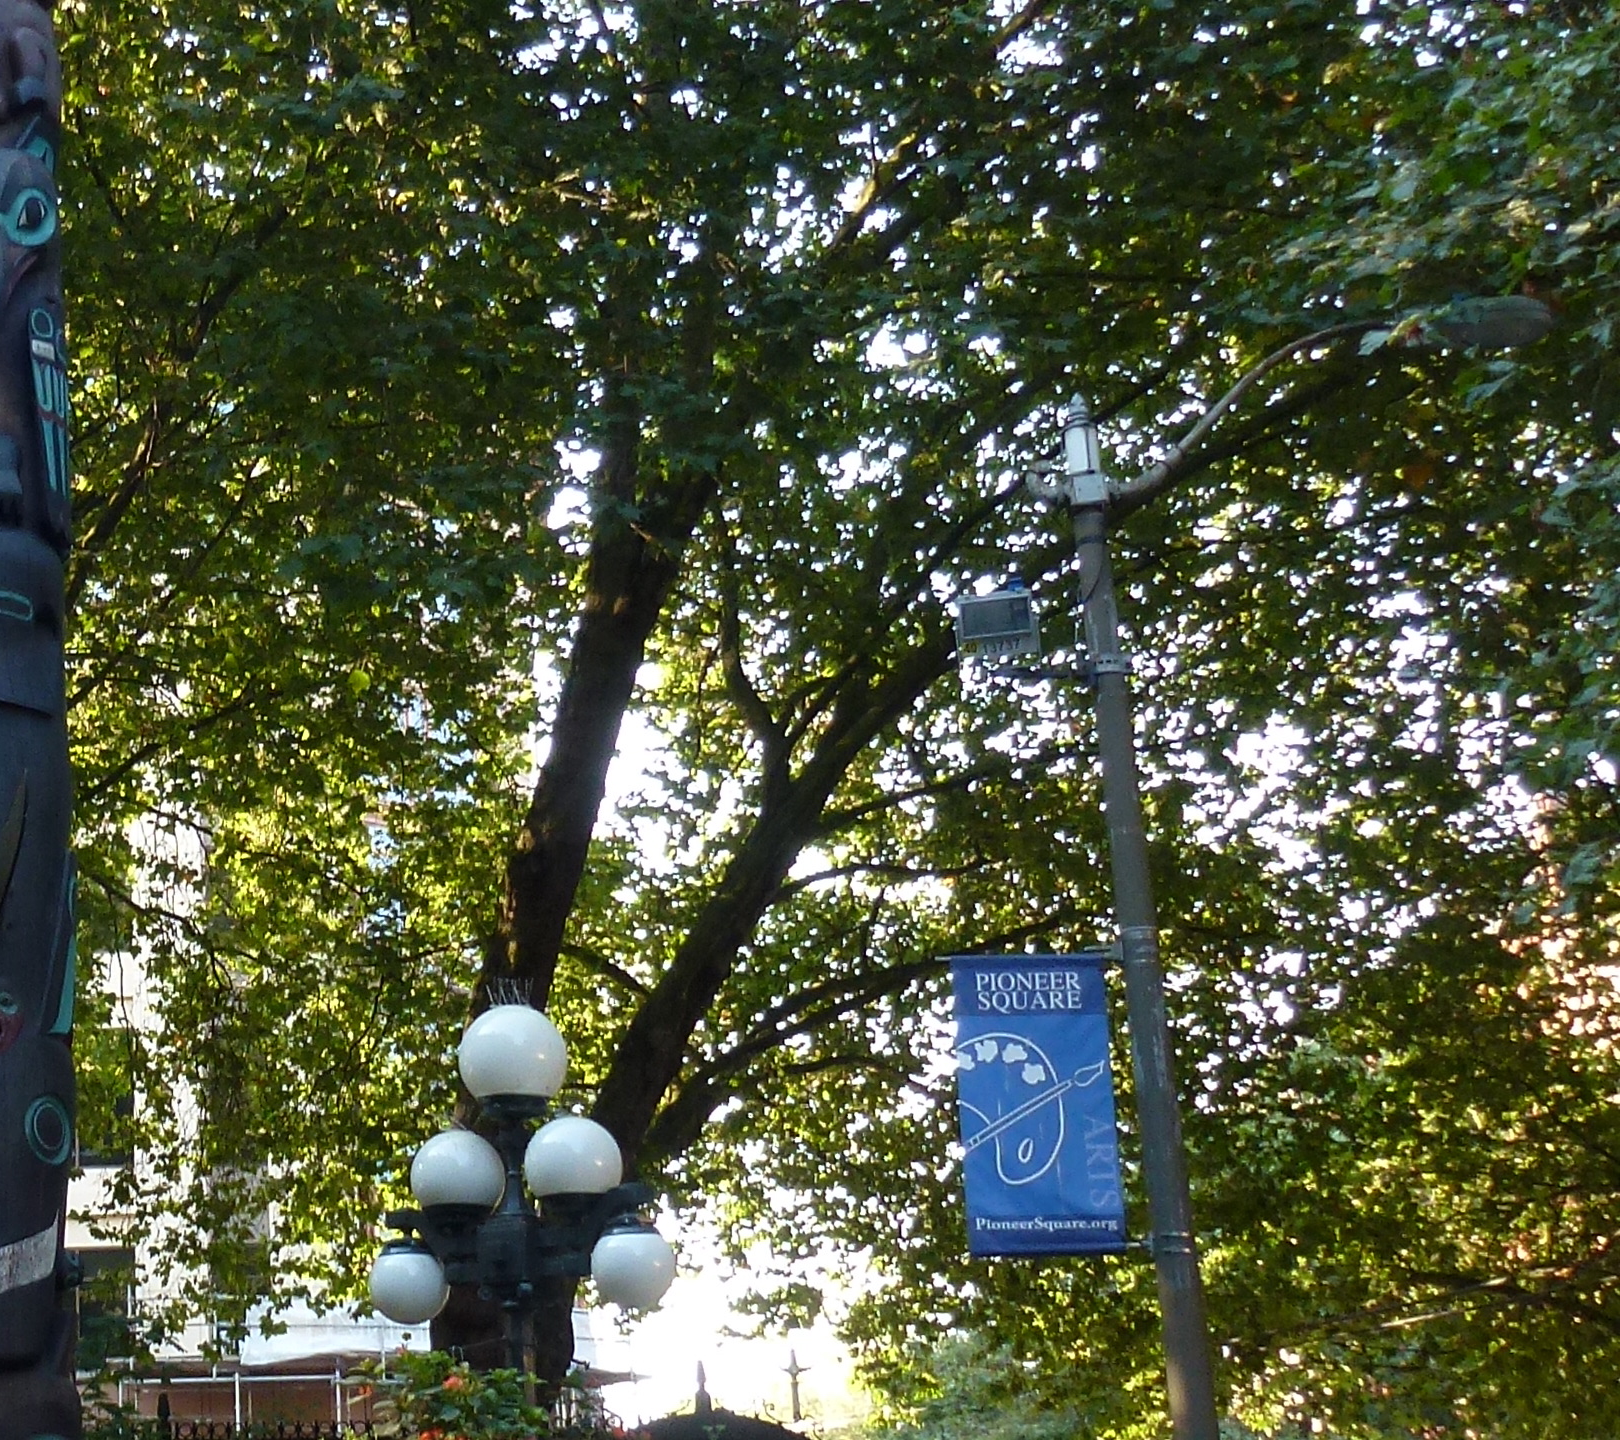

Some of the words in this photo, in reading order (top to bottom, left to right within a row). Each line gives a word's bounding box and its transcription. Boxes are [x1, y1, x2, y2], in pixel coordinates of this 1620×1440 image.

[975, 971, 1081, 991] PIONEER
[977, 991, 1082, 1014] SQUARE
[1084, 1115, 1119, 1207] ARTS
[975, 1216, 1118, 1232] PioneerSquare.org
